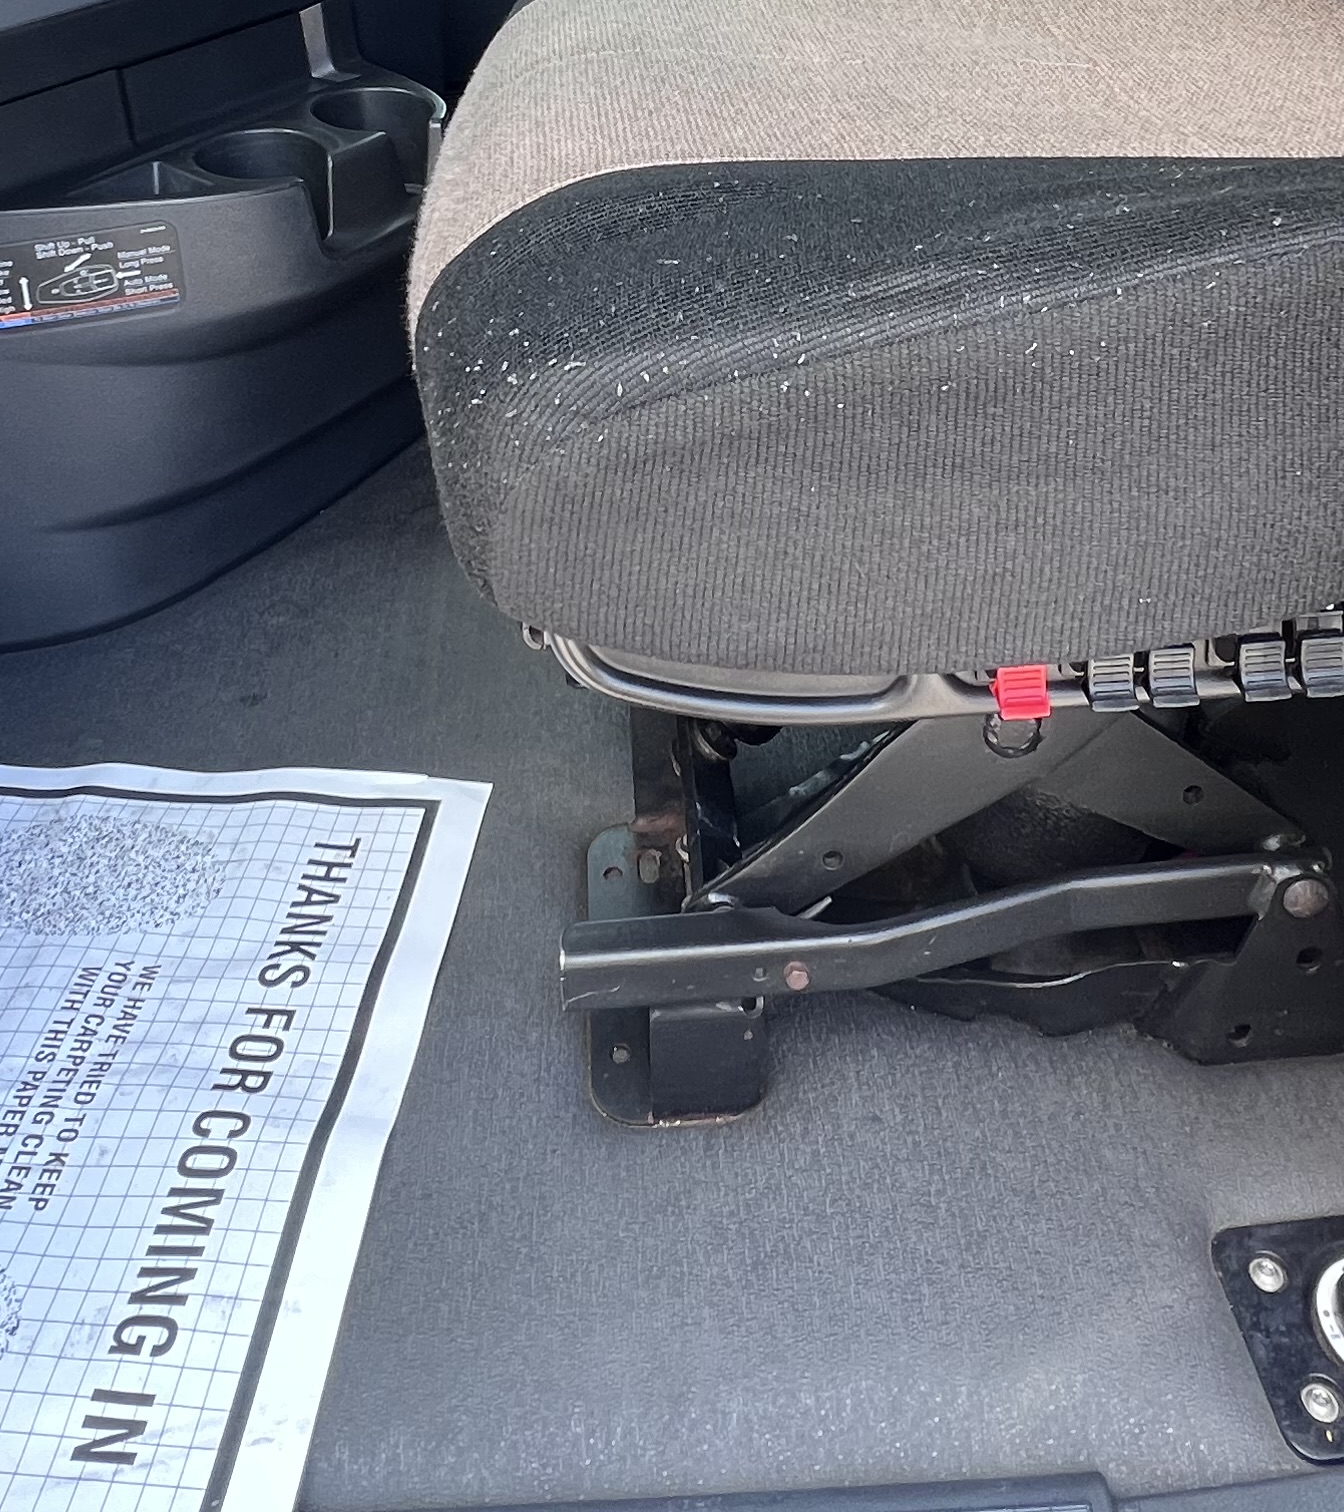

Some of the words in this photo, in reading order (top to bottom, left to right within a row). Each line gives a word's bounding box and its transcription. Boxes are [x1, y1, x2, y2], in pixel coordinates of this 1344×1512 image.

[258, 838, 361, 988] THANKS
[61, 966, 102, 1012] WITH
[92, 961, 135, 1008] YOUR
[132, 964, 162, 992] WE
[34, 1018, 74, 1063] THIS
[105, 997, 145, 1045] HAVE
[31, 1014, 105, 1126] CARPETING
[74, 1049, 118, 1105] TRIED
[211, 1007, 296, 1094] FOR
[57, 1113, 87, 1143] TO
[28, 1152, 69, 1211] KEEP
[108, 1110, 251, 1357] COMING
[70, 1389, 156, 1465] IN
